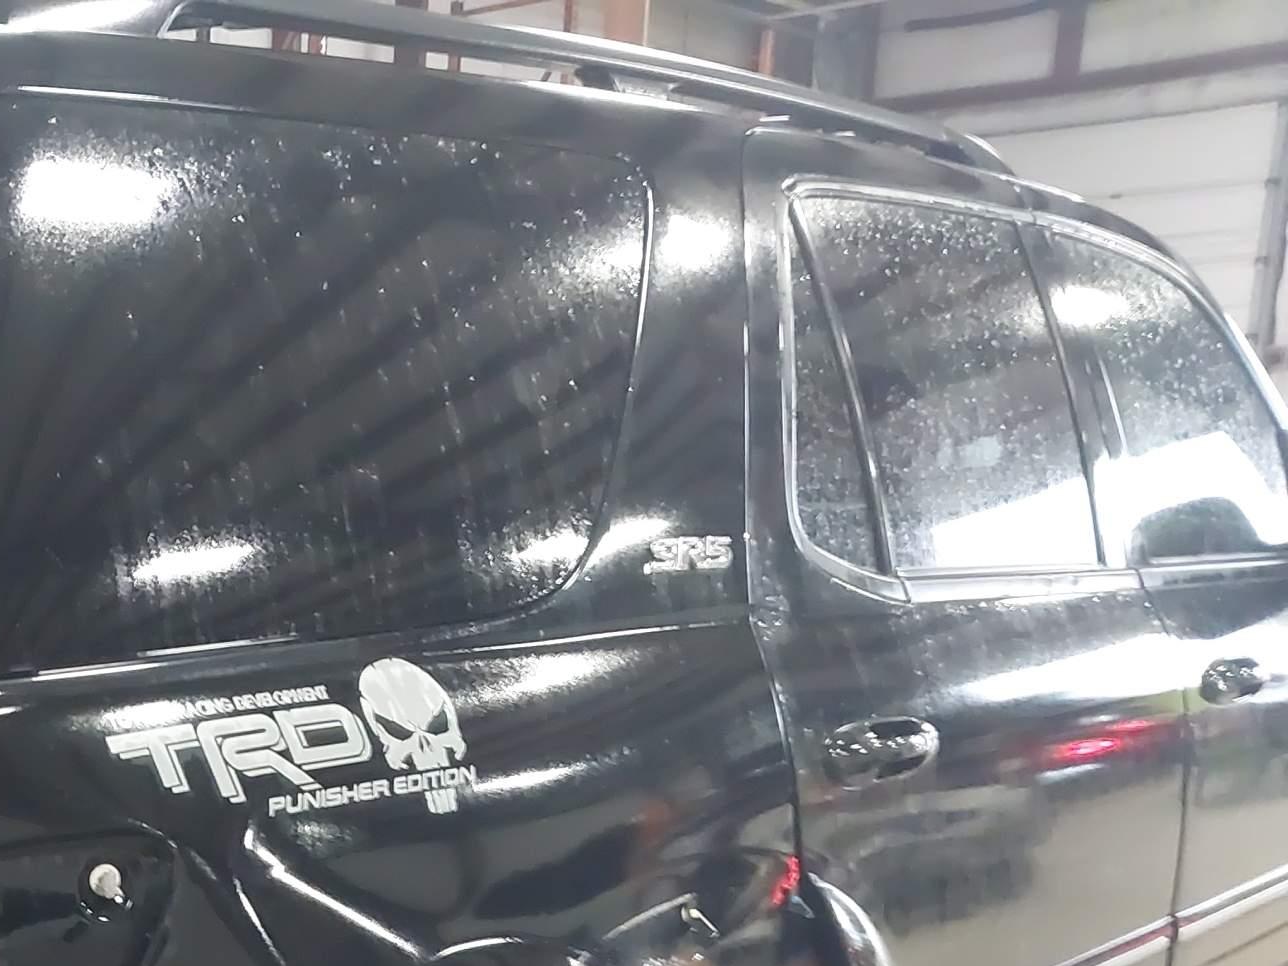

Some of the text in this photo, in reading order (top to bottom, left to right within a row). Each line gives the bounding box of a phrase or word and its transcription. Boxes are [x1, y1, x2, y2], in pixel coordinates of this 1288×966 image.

[643, 534, 734, 575] SR5
[232, 684, 330, 711] DEVELOPMENT
[105, 703, 373, 804] TRD
[269, 764, 477, 817] PUNISHER EDITION
